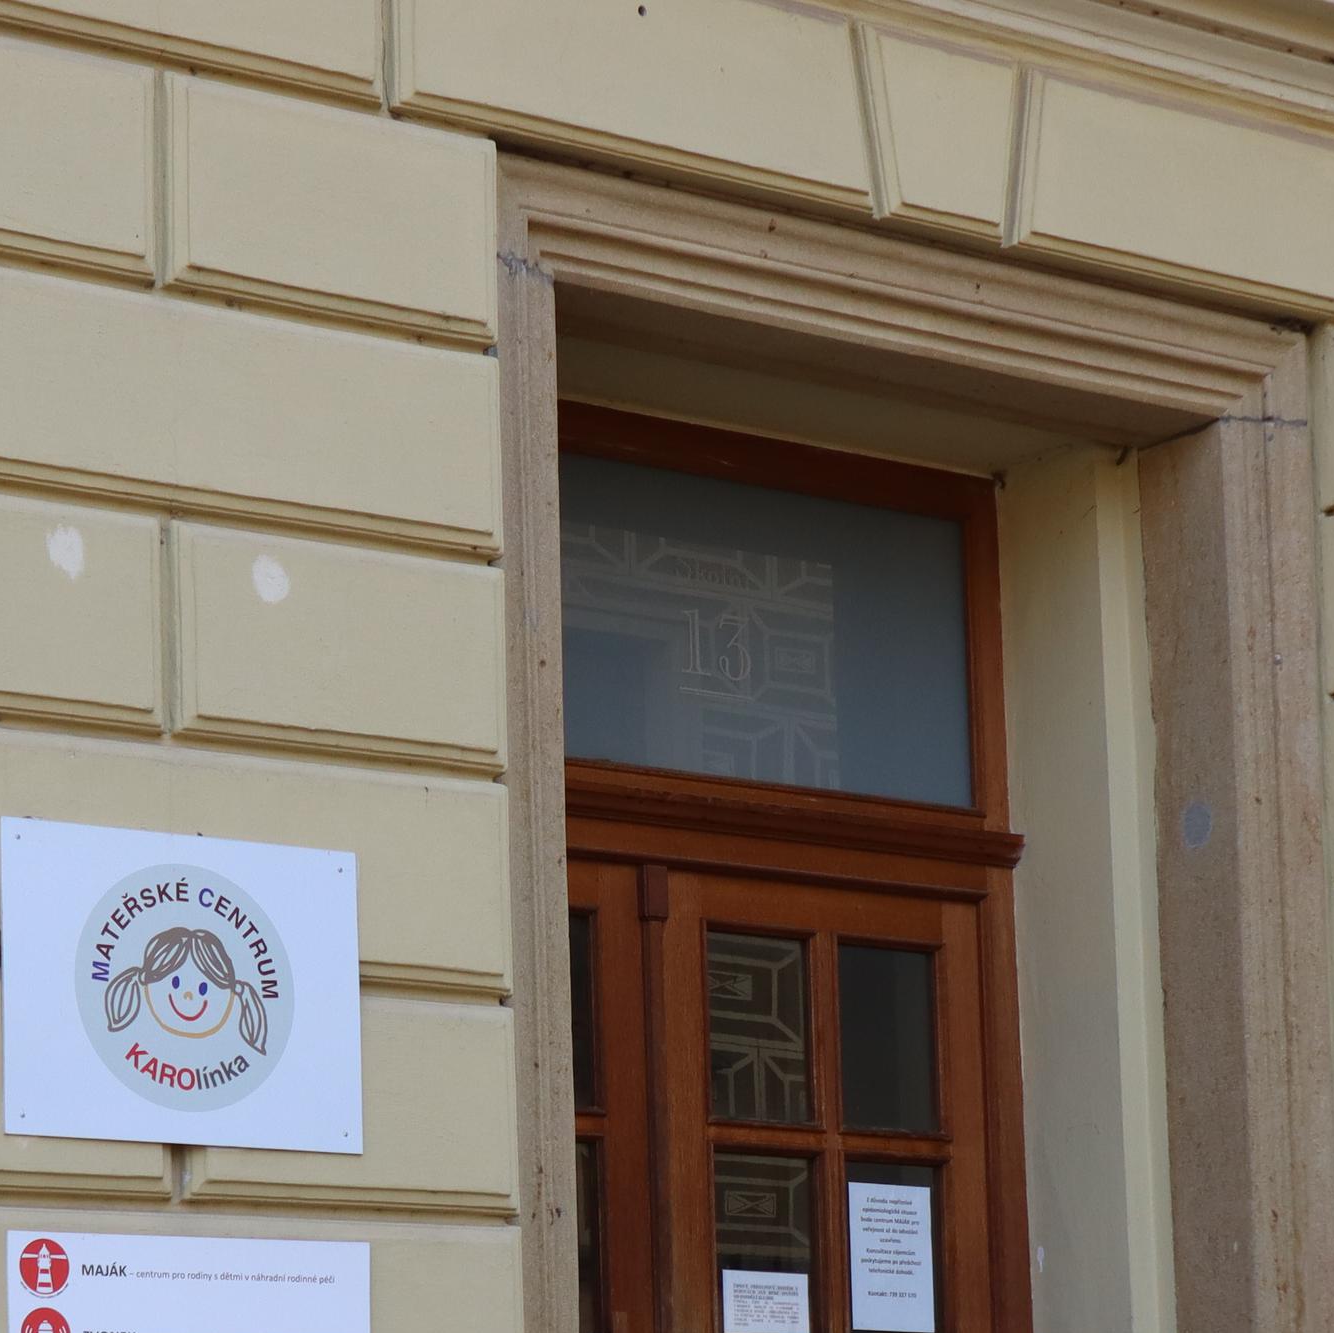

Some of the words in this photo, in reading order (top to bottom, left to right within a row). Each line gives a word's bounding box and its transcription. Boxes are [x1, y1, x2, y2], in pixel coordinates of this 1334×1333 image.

[681, 609, 752, 681] 13
[91, 877, 190, 982] MATEŘSKÉ
[199, 888, 279, 999] CENTRUM
[125, 1043, 250, 1091] KAROlínka
[81, 1261, 127, 1277] MAJÁK
[136, 1271, 170, 1279] centrum
[171, 1272, 186, 1281] pro
[187, 1272, 212, 1281] rodiny
[220, 1272, 243, 1281] dětmi
[251, 1273, 286, 1283] náhradní
[287, 1274, 317, 1284] rodinné
[319, 1276, 335, 1285] péči
